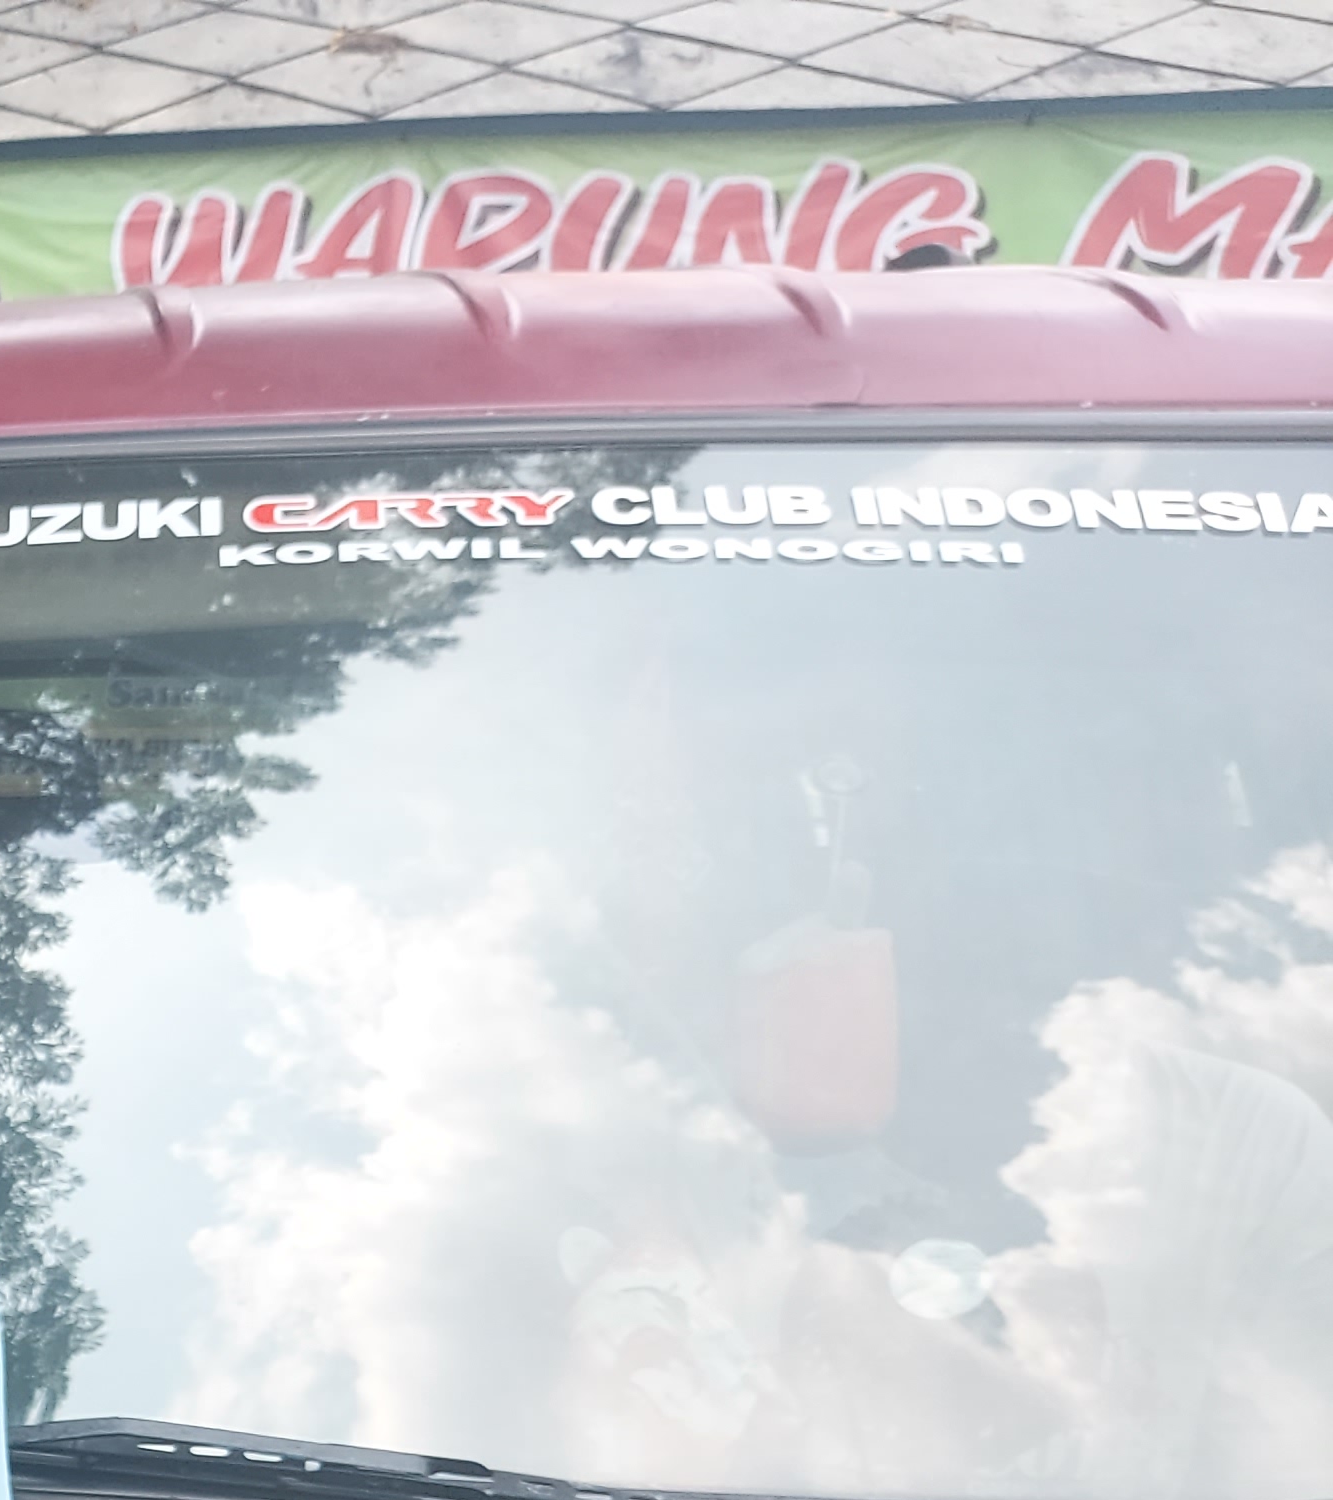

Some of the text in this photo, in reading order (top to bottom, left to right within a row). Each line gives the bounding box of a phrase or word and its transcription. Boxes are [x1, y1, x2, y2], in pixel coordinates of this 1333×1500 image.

[1061, 152, 1333, 280] M
[243, 489, 575, 533] CARRY
[590, 486, 832, 527] CLUB
[850, 486, 1333, 535] INDONESIA
[218, 537, 1025, 569] KORWIL WONOGIRI
